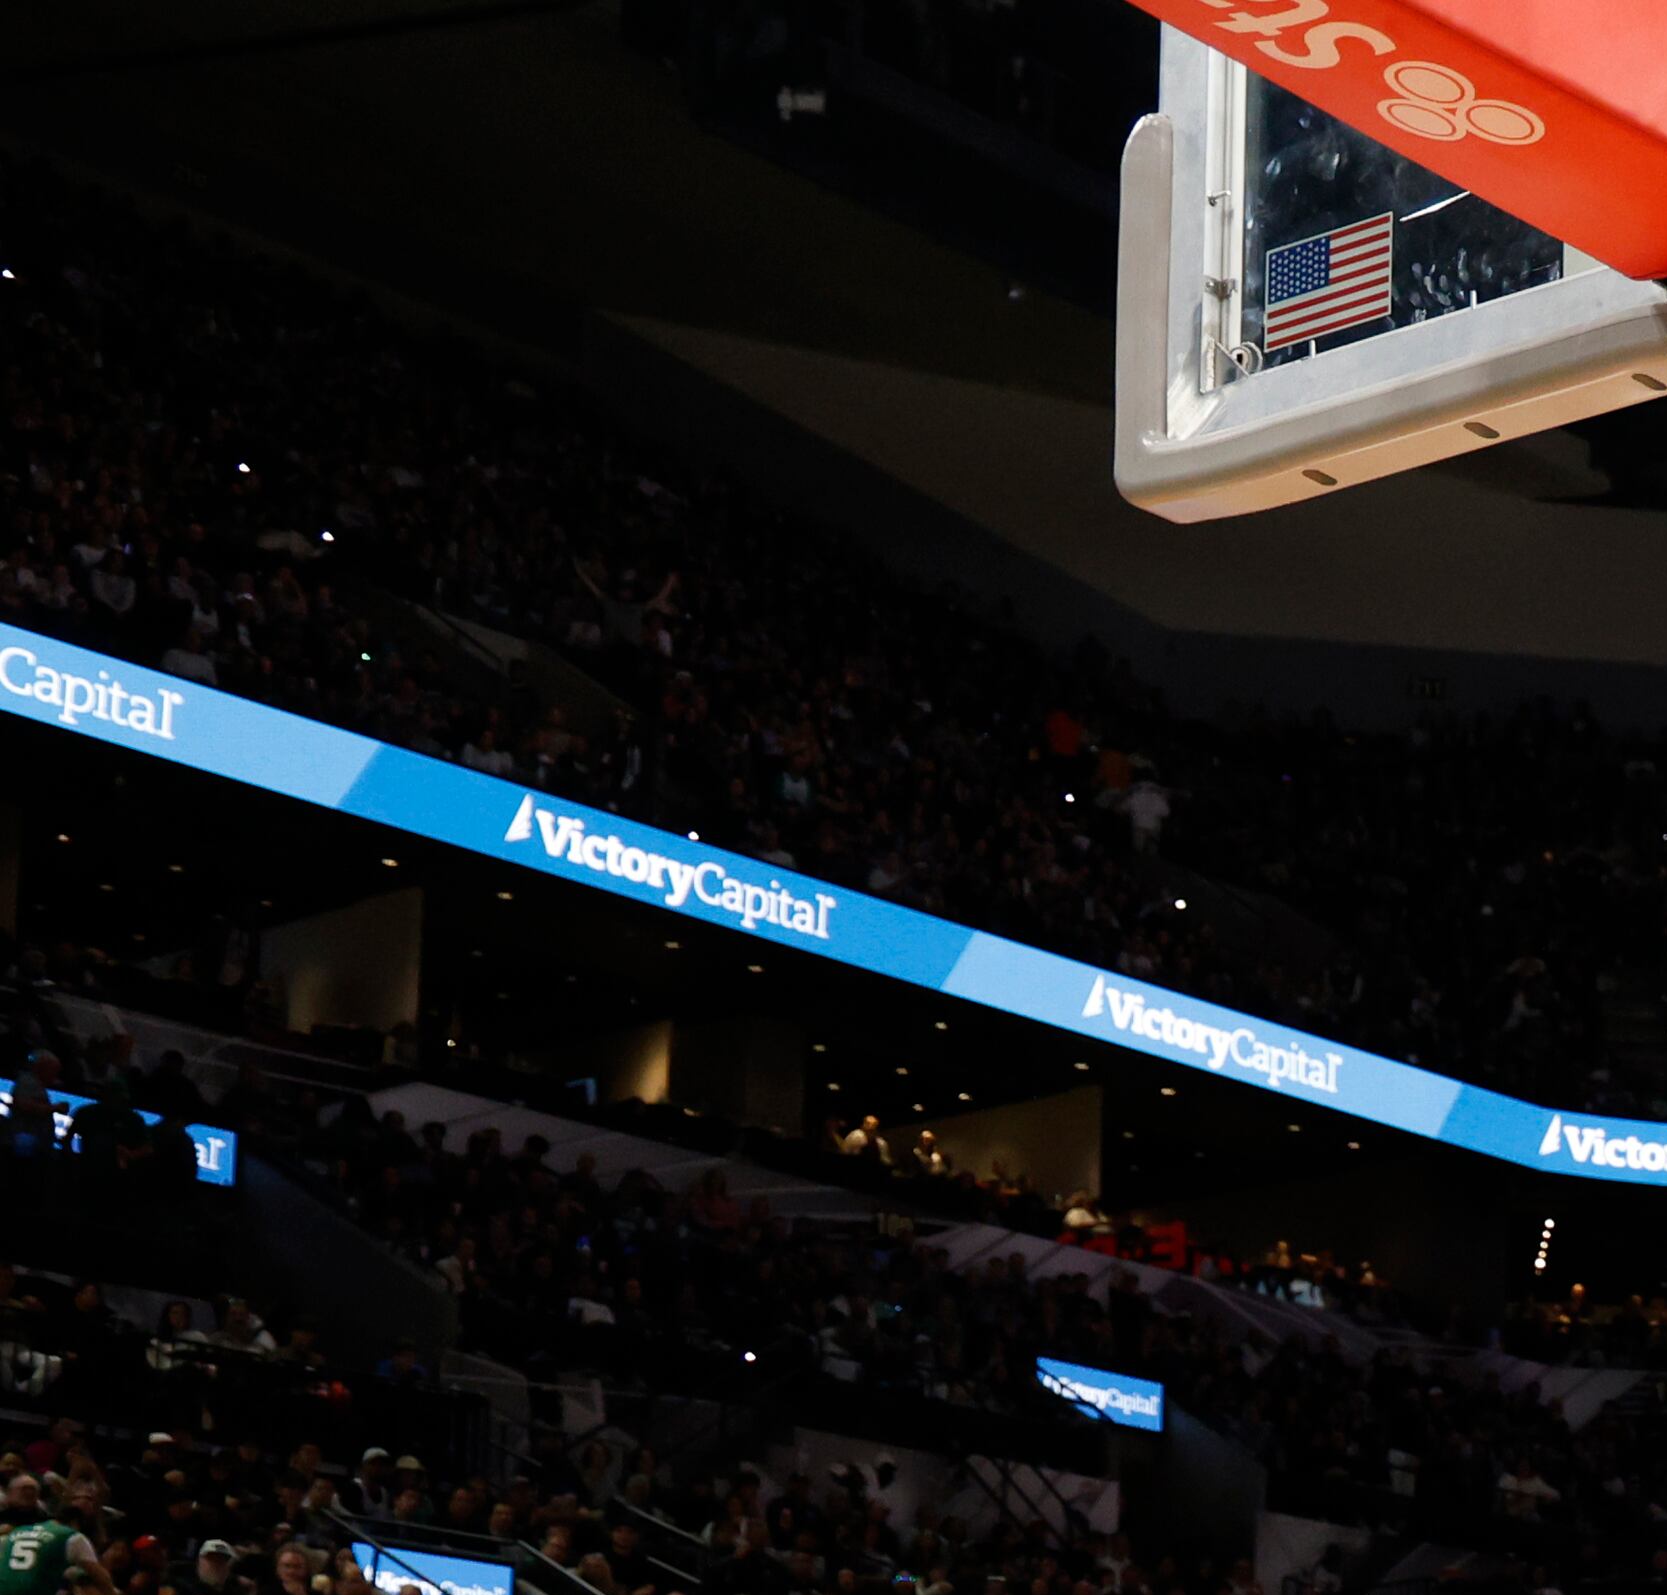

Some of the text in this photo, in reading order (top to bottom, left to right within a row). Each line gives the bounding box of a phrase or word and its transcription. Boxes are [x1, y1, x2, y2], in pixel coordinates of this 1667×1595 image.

[535, 808, 837, 940] VictoryCapital
[1105, 987, 1343, 1094] VictoryCapital
[9, 1540, 40, 1570] 5
